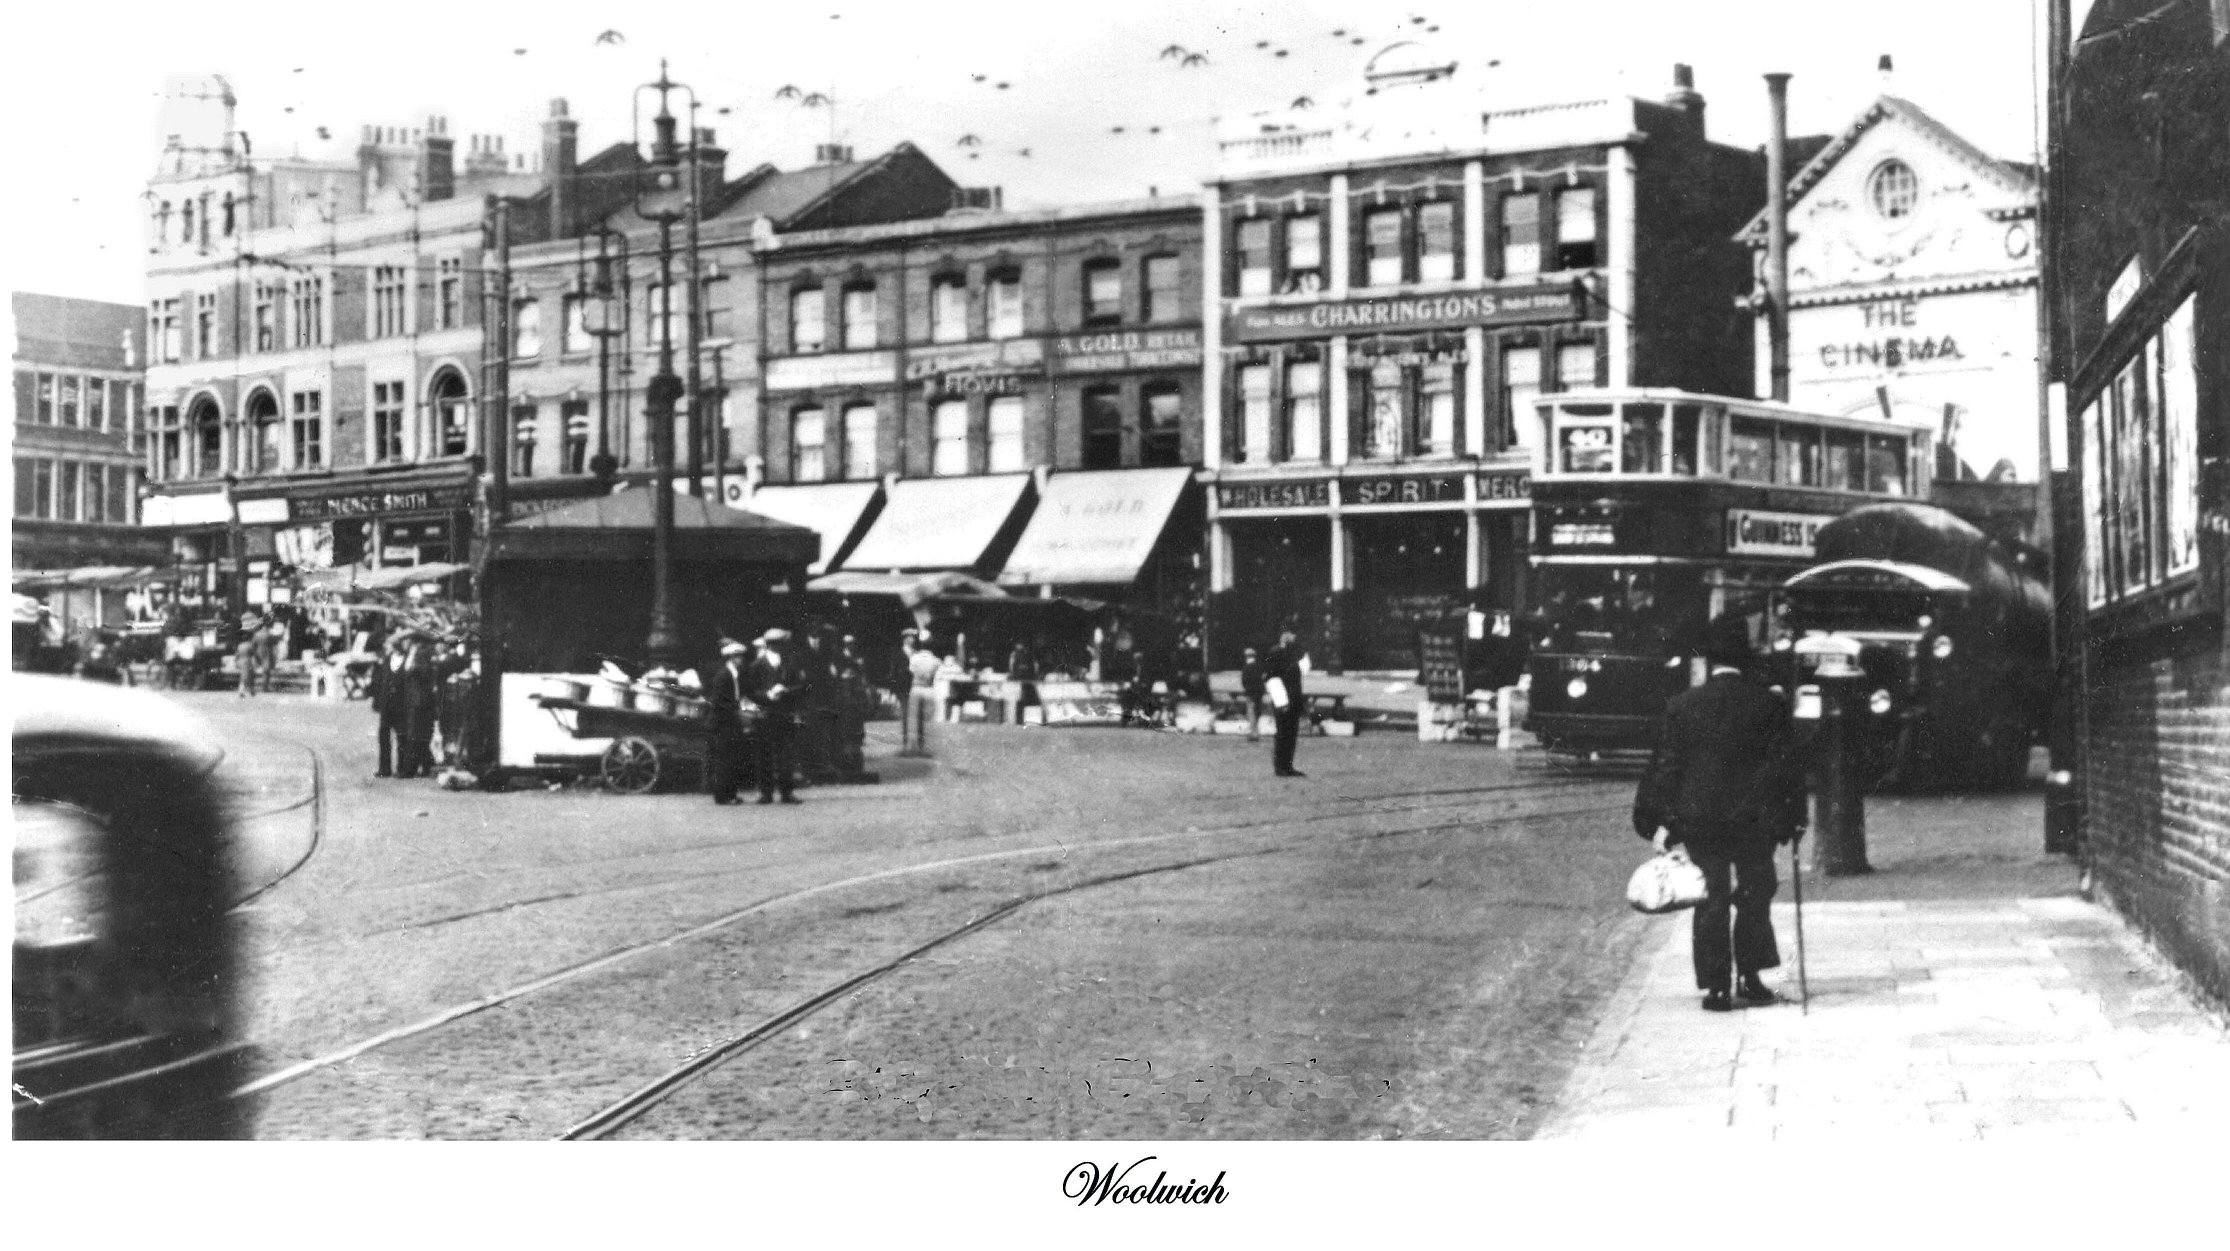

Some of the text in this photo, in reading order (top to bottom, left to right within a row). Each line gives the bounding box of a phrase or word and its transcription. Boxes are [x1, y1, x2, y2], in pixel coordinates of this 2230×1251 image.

[1859, 301, 1918, 328] THE
[1820, 335, 1965, 368] CINEMA
[945, 373, 1022, 394] HOVIS
[384, 492, 427, 510] SMITH
[1220, 484, 1328, 507] WHOLESALE
[1358, 479, 1444, 503] SPIRIT
